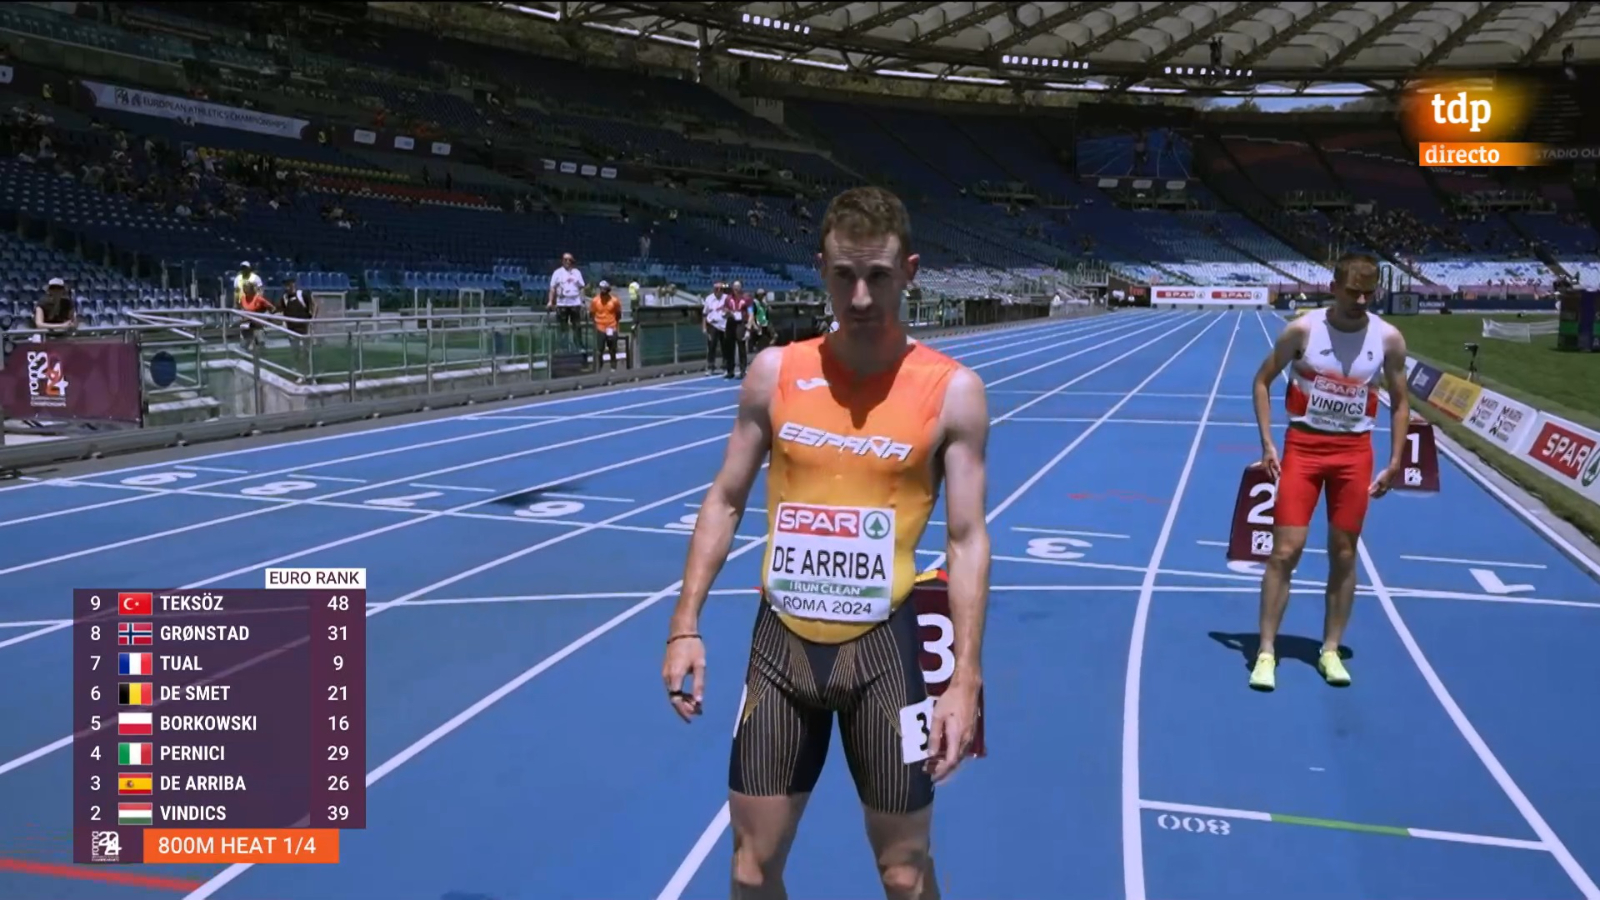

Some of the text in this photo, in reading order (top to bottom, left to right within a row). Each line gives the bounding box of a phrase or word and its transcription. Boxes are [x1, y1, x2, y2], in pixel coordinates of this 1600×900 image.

[143, 97, 187, 114] EUROPEAN
[188, 104, 229, 121] ATHLETICS
[1315, 378, 1357, 396] SPAR
[1311, 395, 1364, 415] VINDICS
[779, 421, 913, 461] ESPAÑA
[1406, 433, 1420, 464] 1
[1542, 432, 1591, 471] SPAR
[240, 480, 317, 496] 8
[1247, 482, 1276, 525] 2
[779, 508, 857, 534] SPAR
[1025, 537, 1093, 560] 3
[772, 546, 886, 580] DE ARRIBA
[794, 582, 819, 592] RUN
[820, 583, 861, 595] CLEAN
[782, 595, 872, 615] ROMA 2024
[916, 613, 956, 684] 3
[916, 712, 930, 751] 3
[1156, 813, 1232, 836] 800
